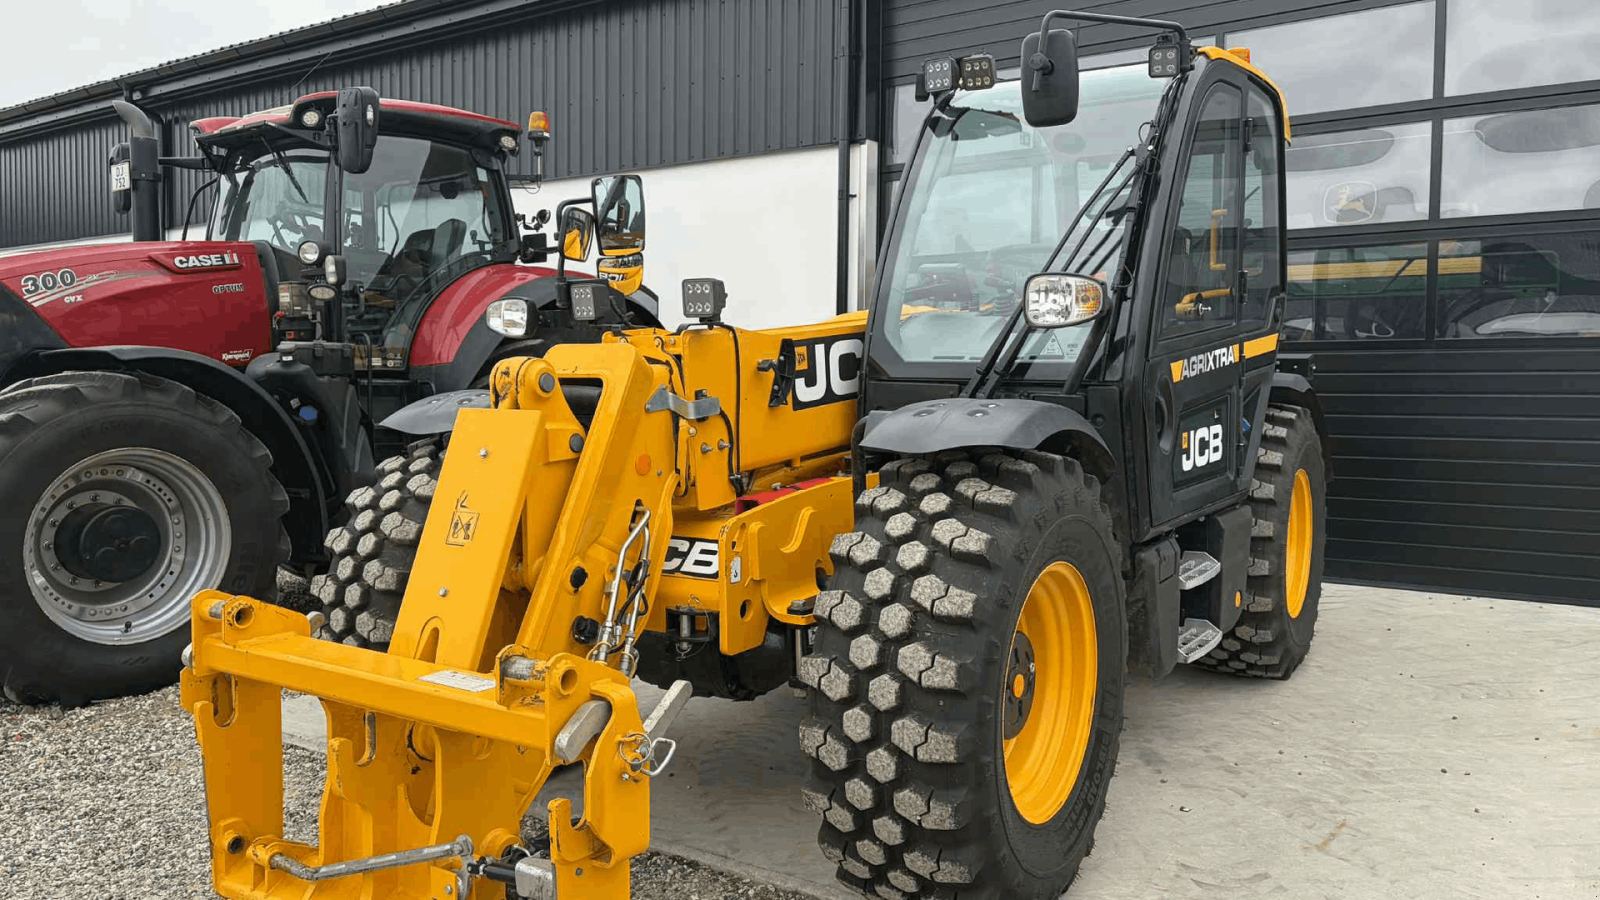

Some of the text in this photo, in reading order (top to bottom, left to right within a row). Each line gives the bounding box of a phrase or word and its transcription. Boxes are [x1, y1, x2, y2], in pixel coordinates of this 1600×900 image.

[174, 254, 223, 268] CASE
[21, 268, 77, 295] 300
[212, 283, 245, 294] OPTUM
[794, 338, 864, 402] JC
[1181, 345, 1235, 380] AGRIXTRA
[1181, 424, 1223, 471] JCB
[662, 538, 719, 575] CB
